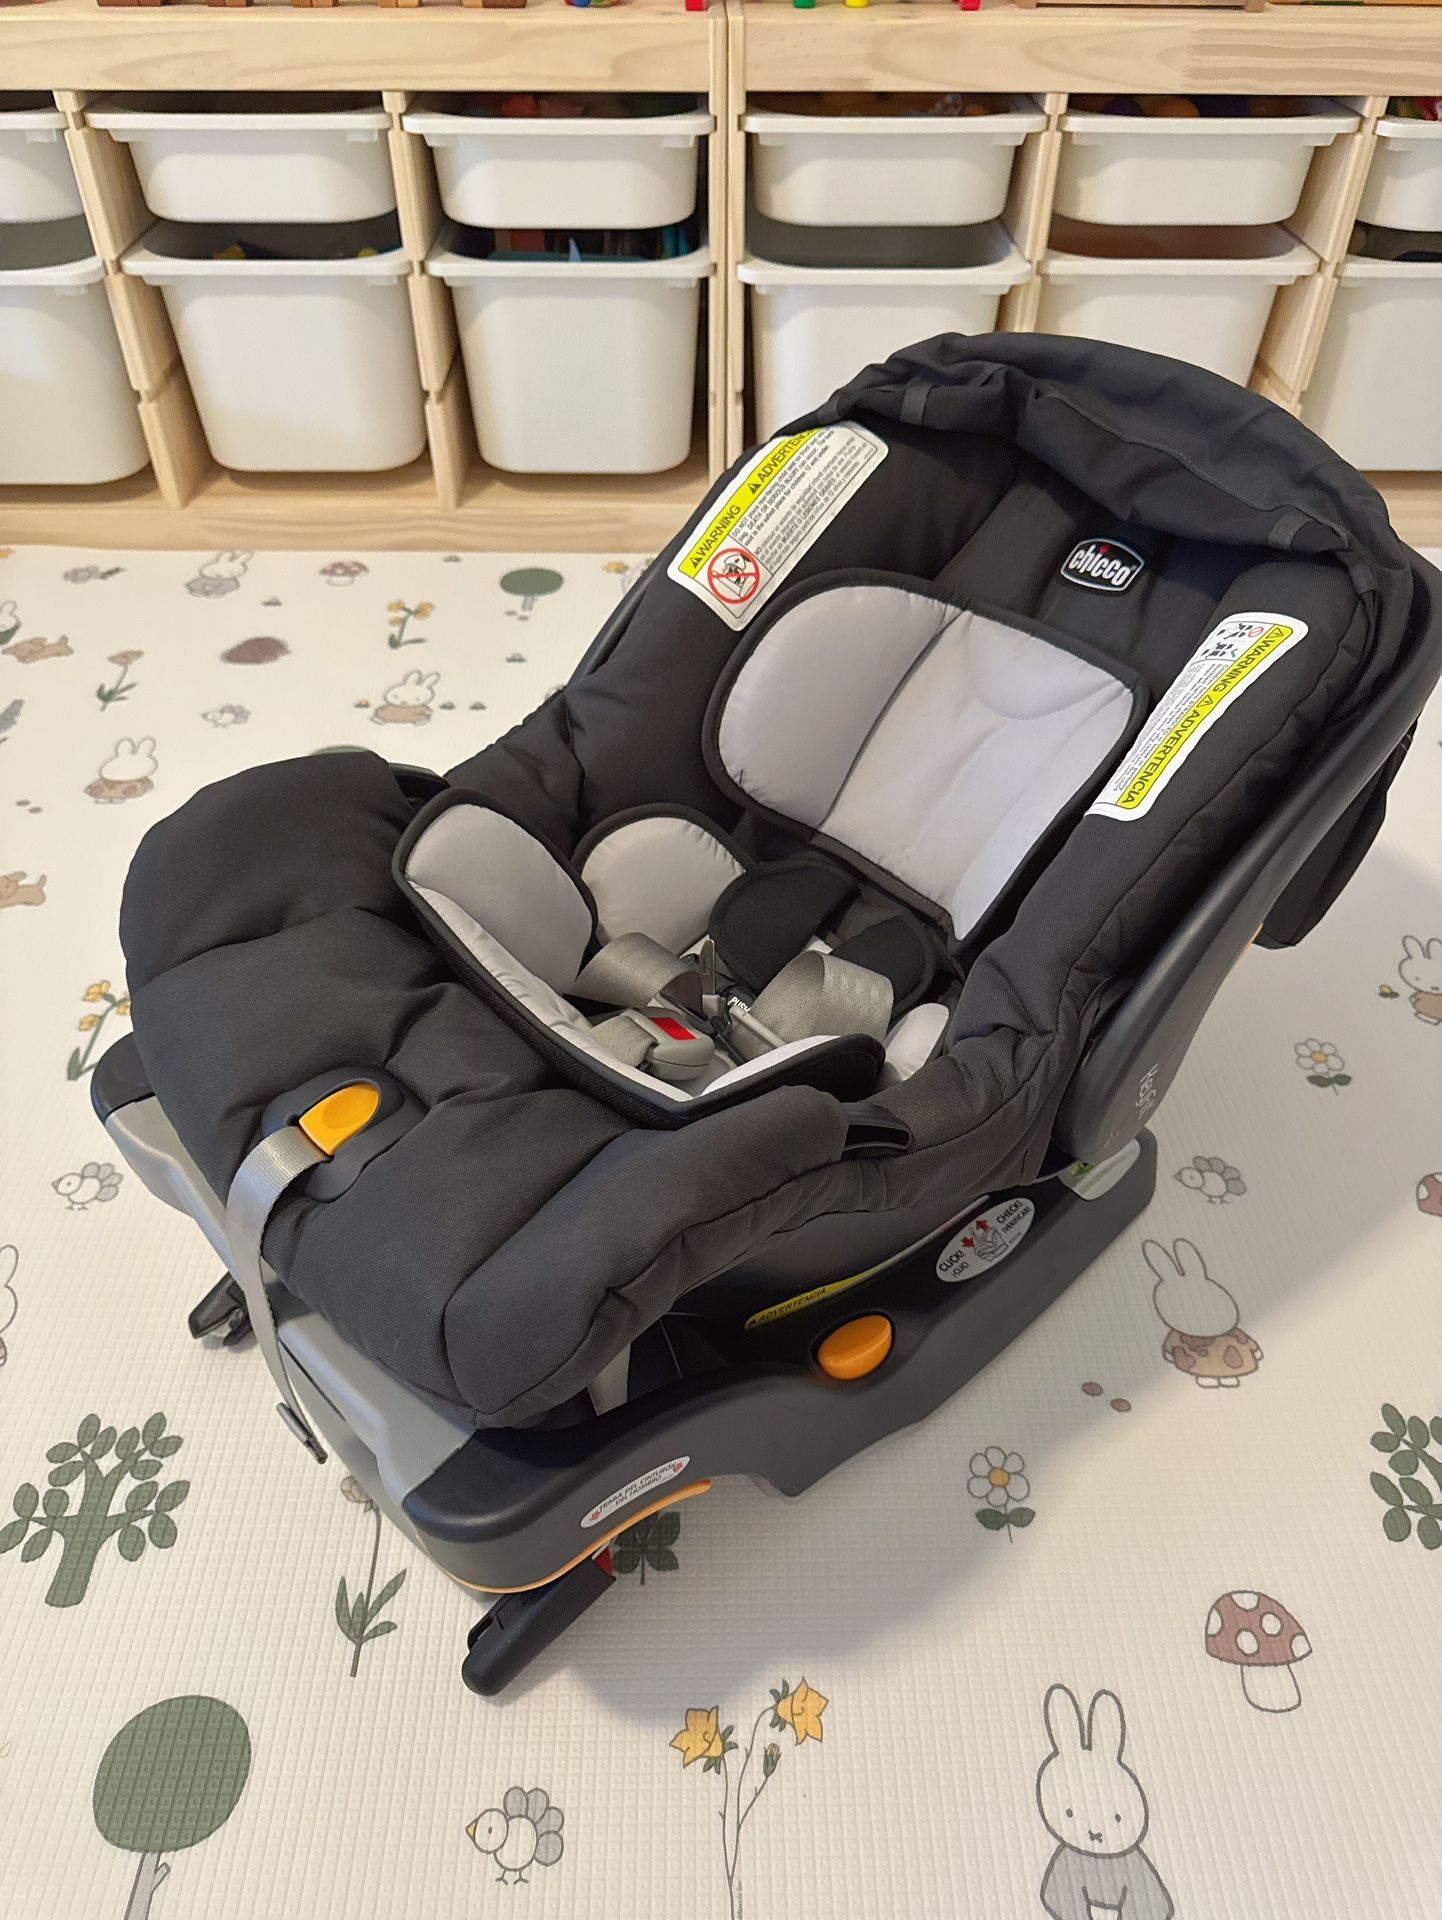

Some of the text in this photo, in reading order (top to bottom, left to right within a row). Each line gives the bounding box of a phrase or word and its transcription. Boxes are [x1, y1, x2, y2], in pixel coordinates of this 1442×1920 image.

[746, 511, 763, 530] DEATH
[765, 482, 786, 505] SERIOUS
[782, 466, 800, 485] INJURY
[773, 495, 788, 510] place
[788, 470, 807, 489] children
[695, 504, 742, 558] WARNING
[737, 516, 749, 529] NOT
[1068, 544, 1131, 586] chicco
[1213, 639, 1275, 693] WARNING
[1122, 709, 1200, 804] ADVERTENCIA
[996, 1200, 1023, 1224] CHECK!
[939, 1249, 965, 1272] CLICK!
[759, 1287, 826, 1321] ADVERTENCIA
[624, 1483, 637, 1493] DEL
